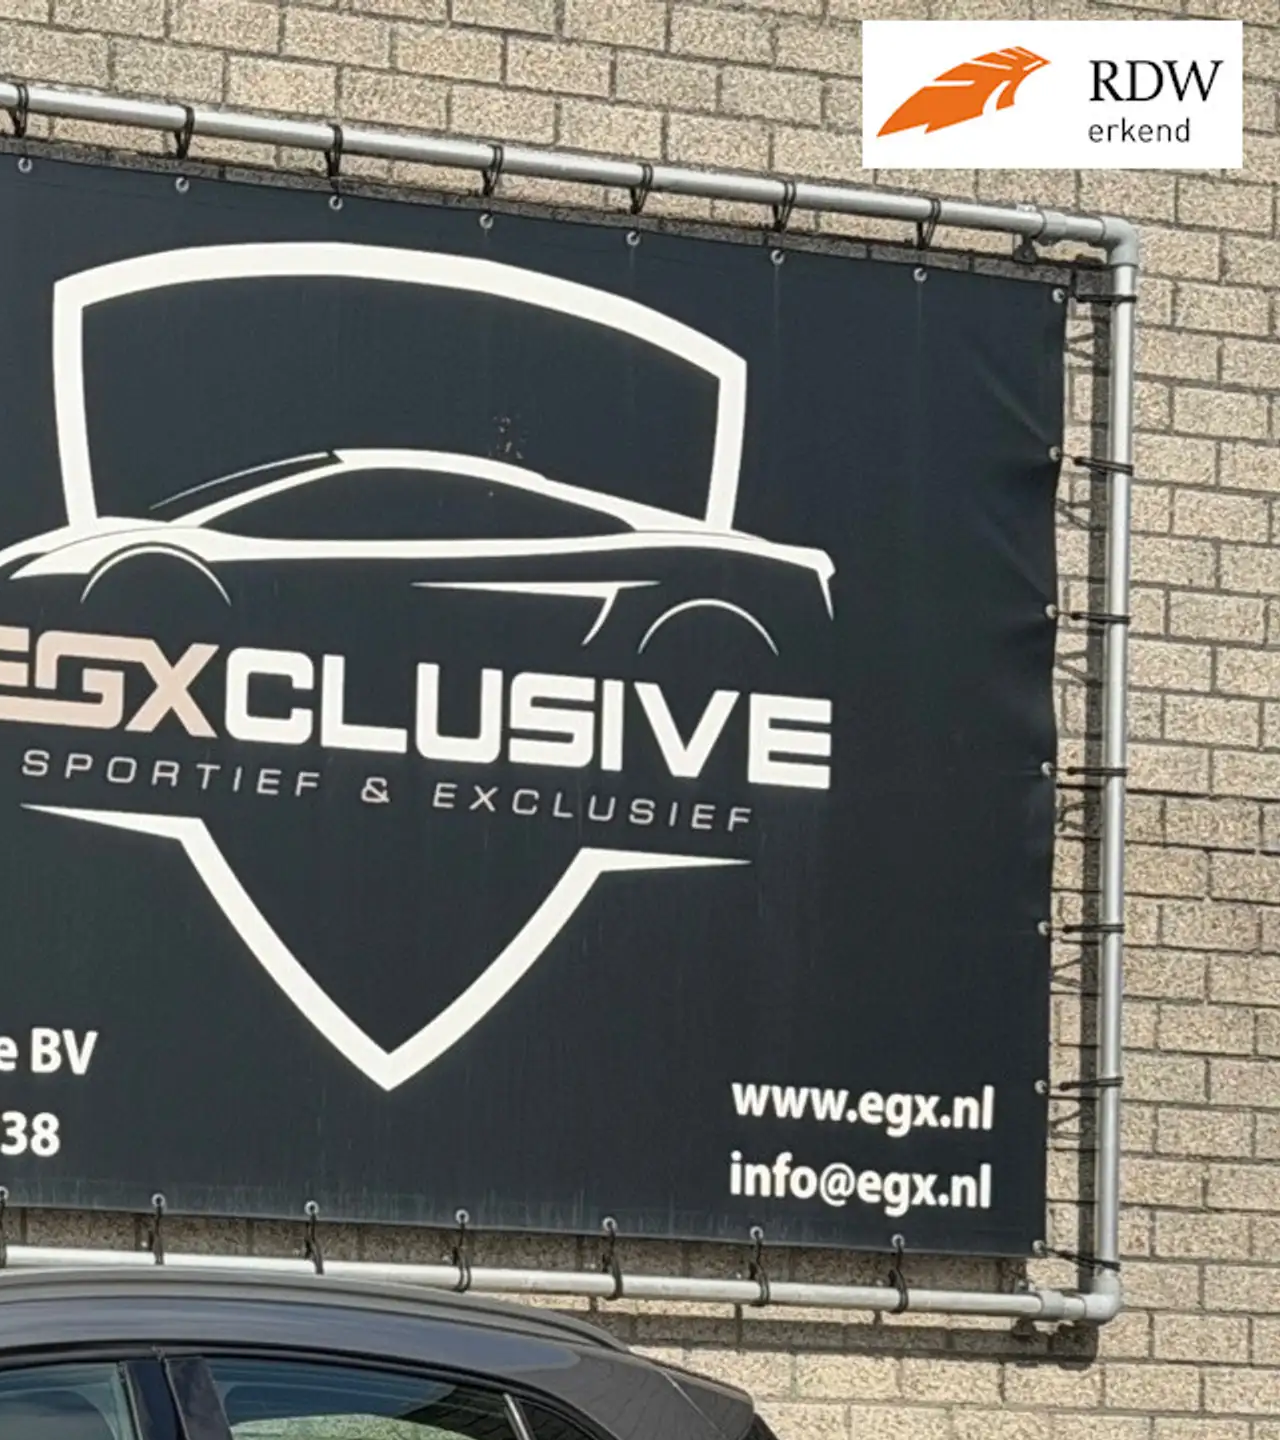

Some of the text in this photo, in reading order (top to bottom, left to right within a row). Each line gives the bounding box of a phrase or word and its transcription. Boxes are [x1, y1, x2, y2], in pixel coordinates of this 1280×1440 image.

[21, 749, 754, 833] SPORTIEF & EXCLUSIEF
[31, 1027, 98, 1075] BV
[731, 1082, 995, 1137] www.egx.nl
[730, 1151, 992, 1216] info@egx.nl
